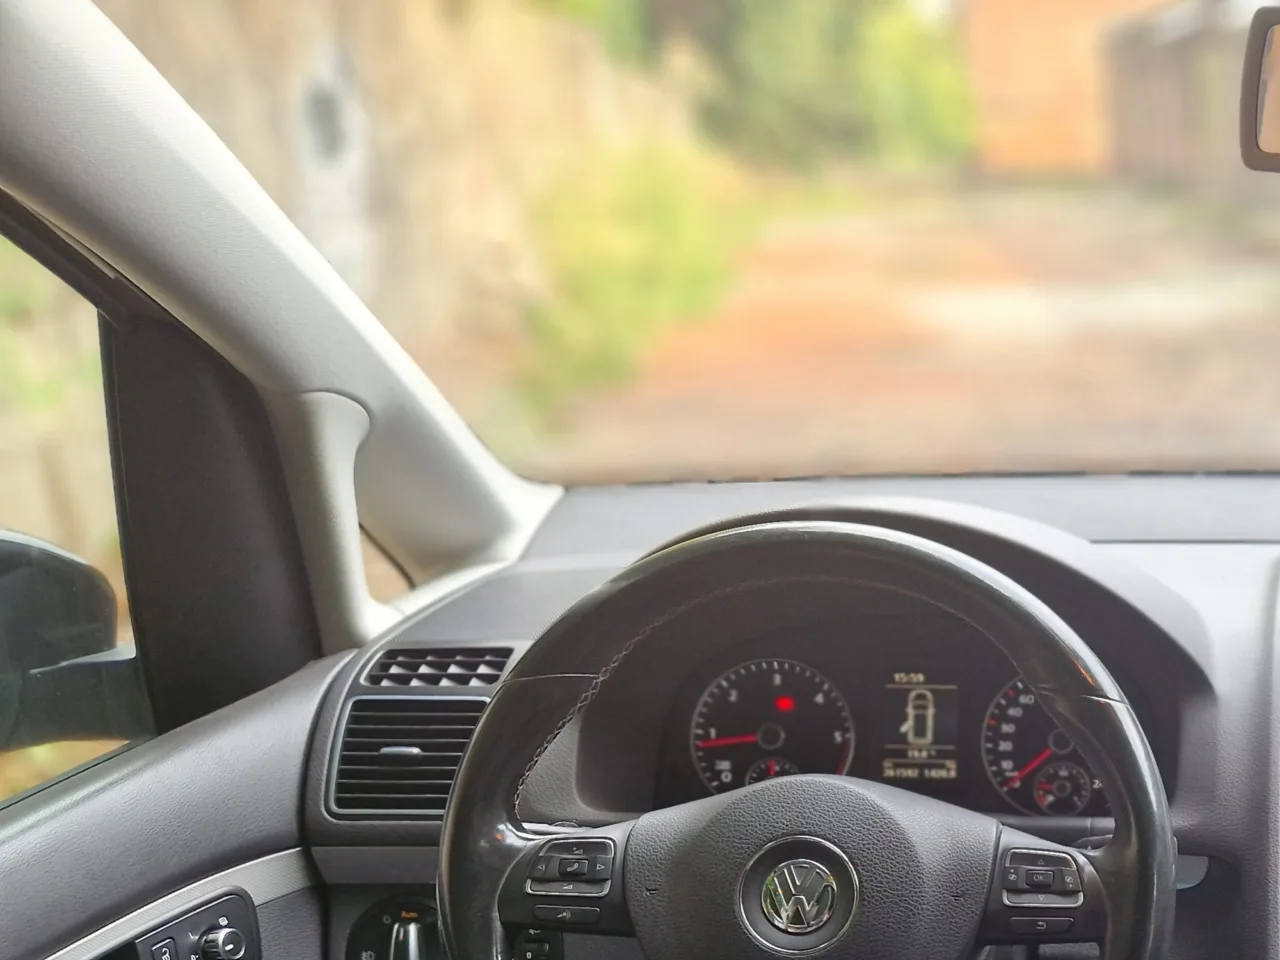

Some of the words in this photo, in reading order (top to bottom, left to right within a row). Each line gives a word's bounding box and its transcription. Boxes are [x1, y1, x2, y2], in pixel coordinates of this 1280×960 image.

[813, 692, 824, 704] 4
[1018, 694, 1034, 705] 60
[834, 731, 843, 743] 5
[721, 771, 732, 783] 0
[1033, 874, 1045, 882] OK
